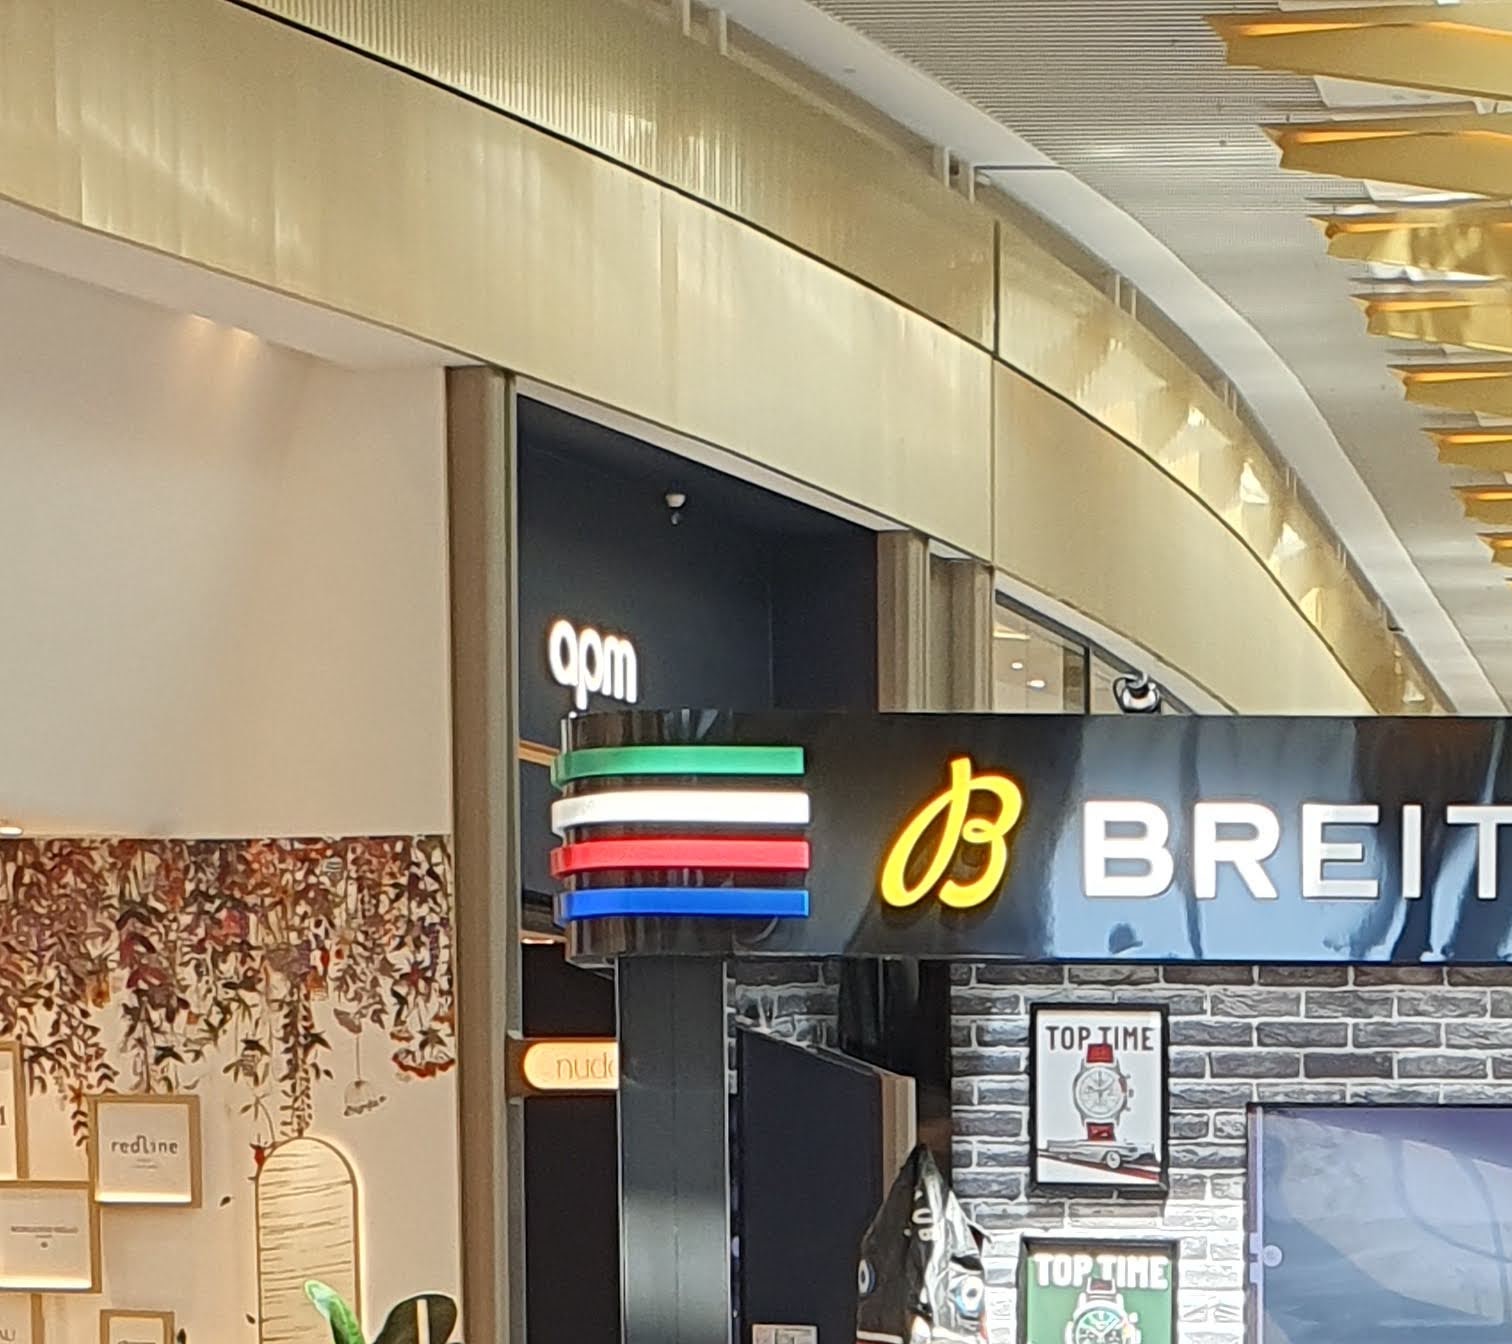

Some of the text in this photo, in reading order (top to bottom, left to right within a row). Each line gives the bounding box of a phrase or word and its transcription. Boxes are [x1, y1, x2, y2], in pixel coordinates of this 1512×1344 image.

[548, 619, 637, 710] apm
[1046, 1026, 1155, 1051] TOP TIME
[111, 1135, 178, 1155] redline
[1033, 1253, 1169, 1290] TOP TIME
